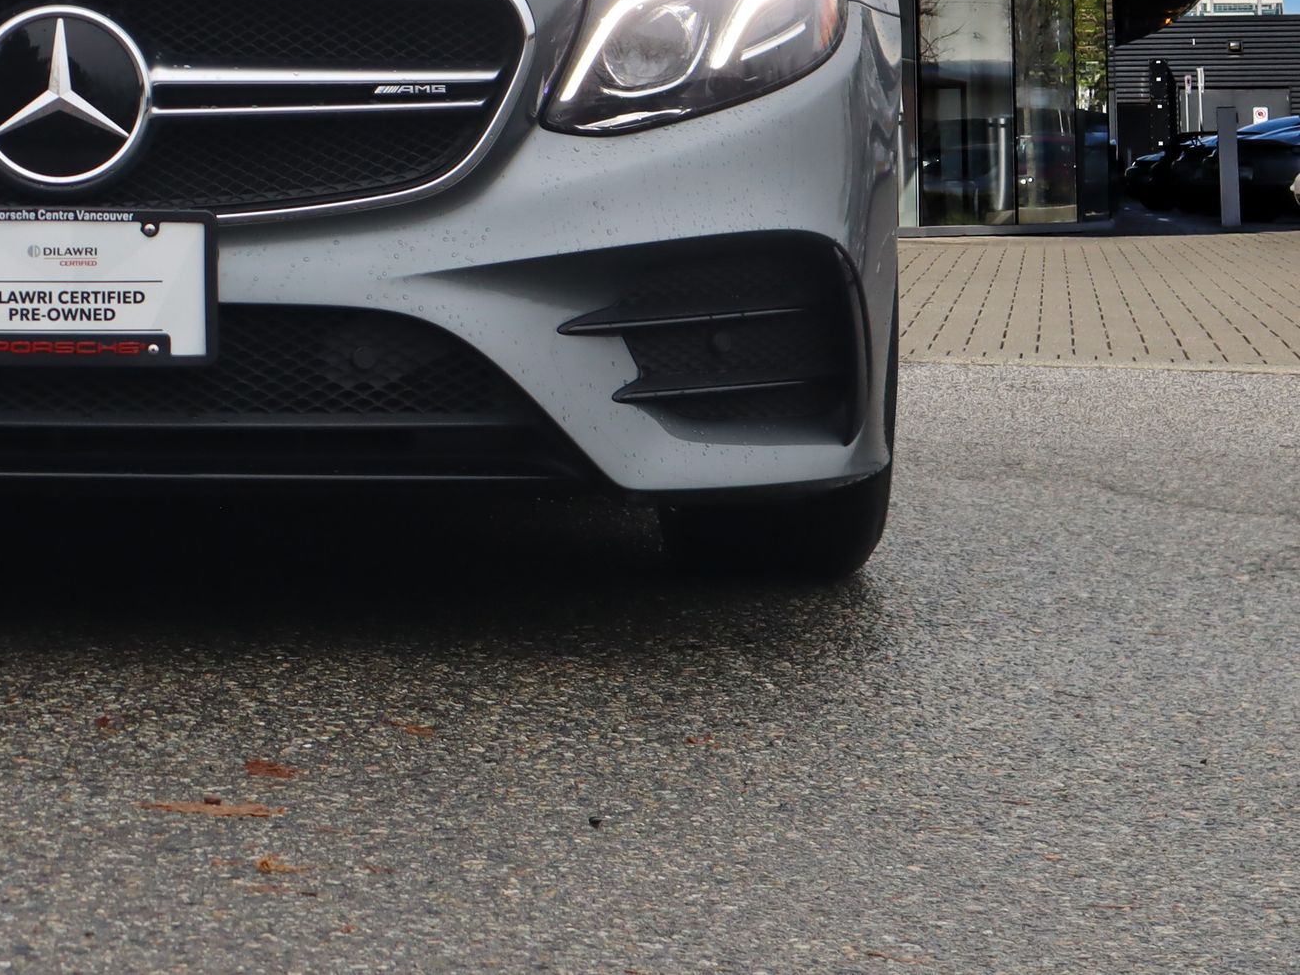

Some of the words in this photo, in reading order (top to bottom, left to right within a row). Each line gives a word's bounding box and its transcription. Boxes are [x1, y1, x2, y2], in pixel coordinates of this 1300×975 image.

[397, 85, 446, 93] AMG
[37, 210, 74, 220] Centre
[76, 210, 134, 221] Vancouver
[43, 247, 98, 256] DILAWRI
[58, 291, 145, 304] CERTIFIED
[9, 308, 116, 321] PRE-OWNED
